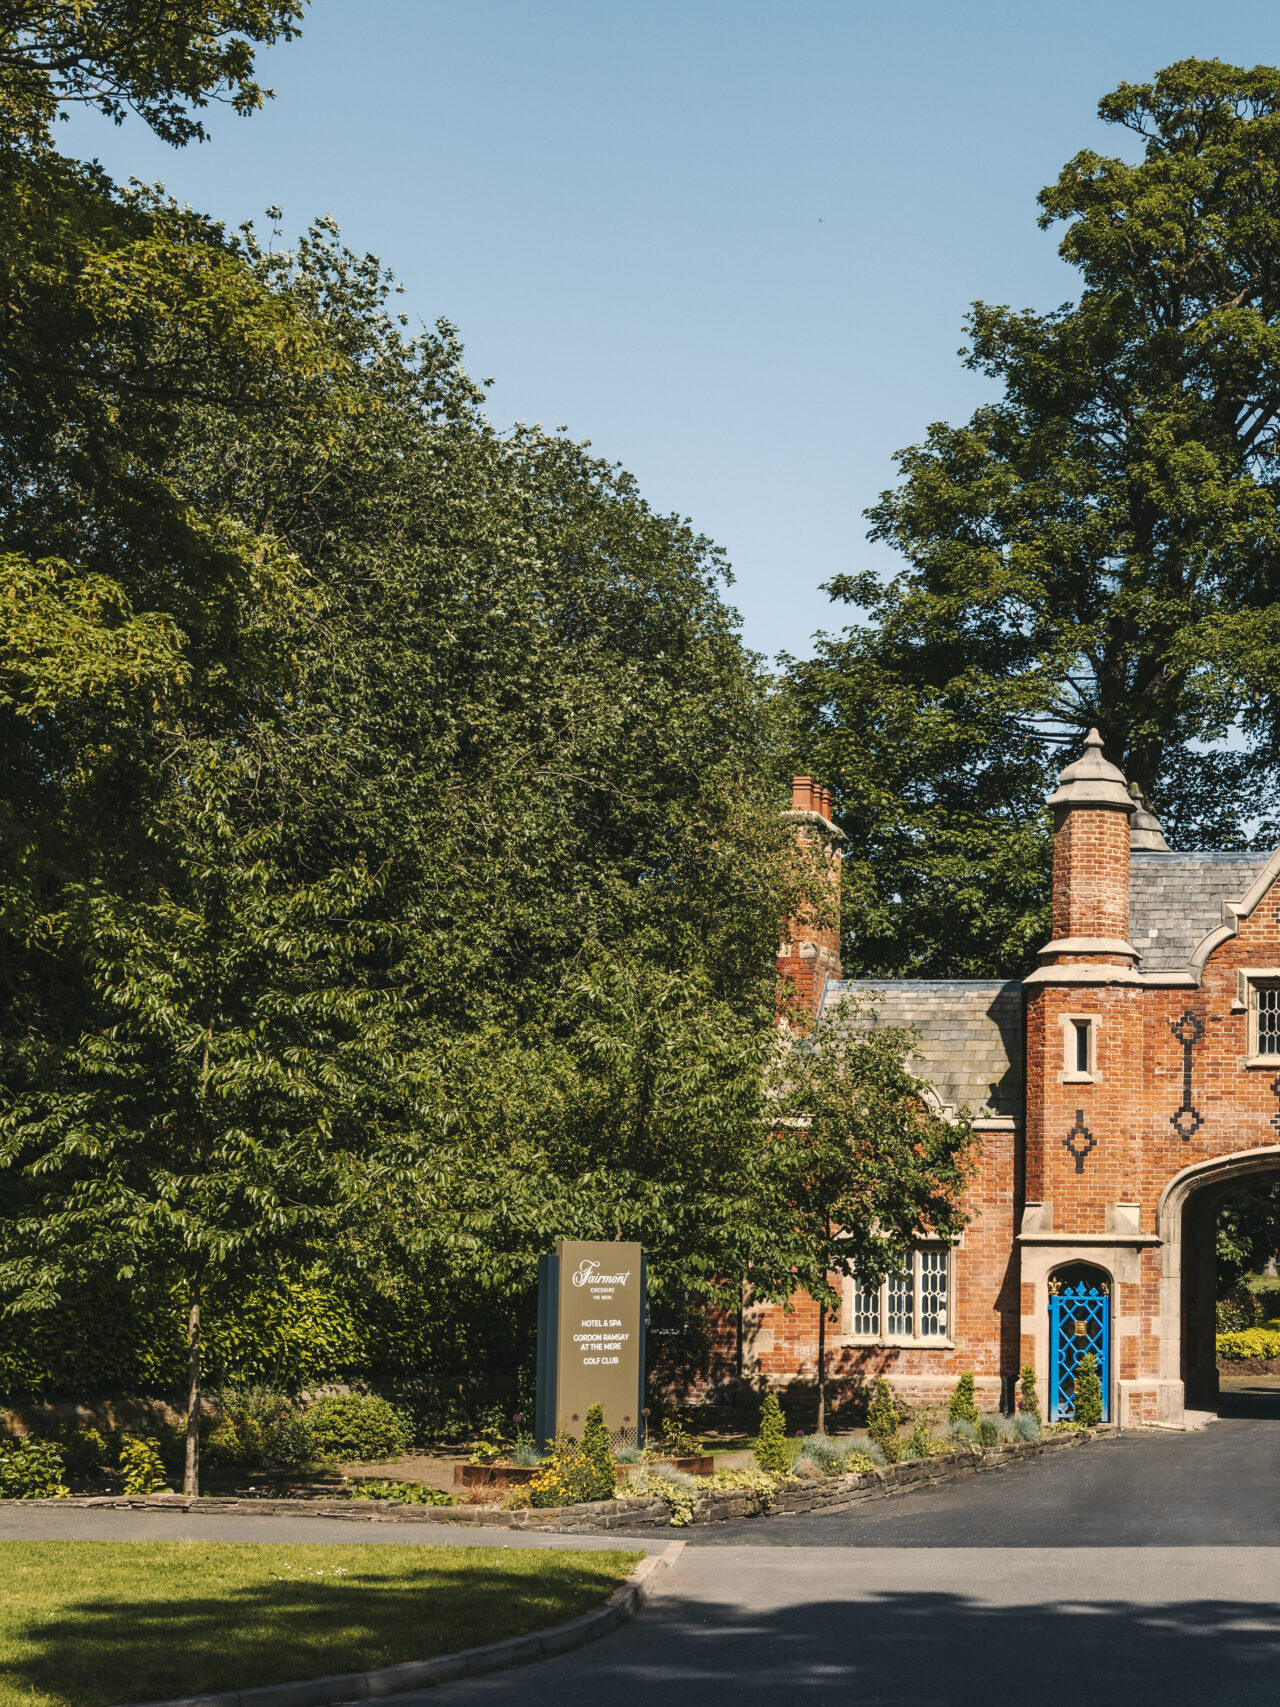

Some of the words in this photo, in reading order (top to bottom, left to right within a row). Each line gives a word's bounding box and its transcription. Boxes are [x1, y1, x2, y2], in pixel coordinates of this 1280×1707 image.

[572, 1259, 631, 1287] Fairmont
[573, 1334, 602, 1342] GORDON
[603, 1333, 629, 1341] RAMSAY
